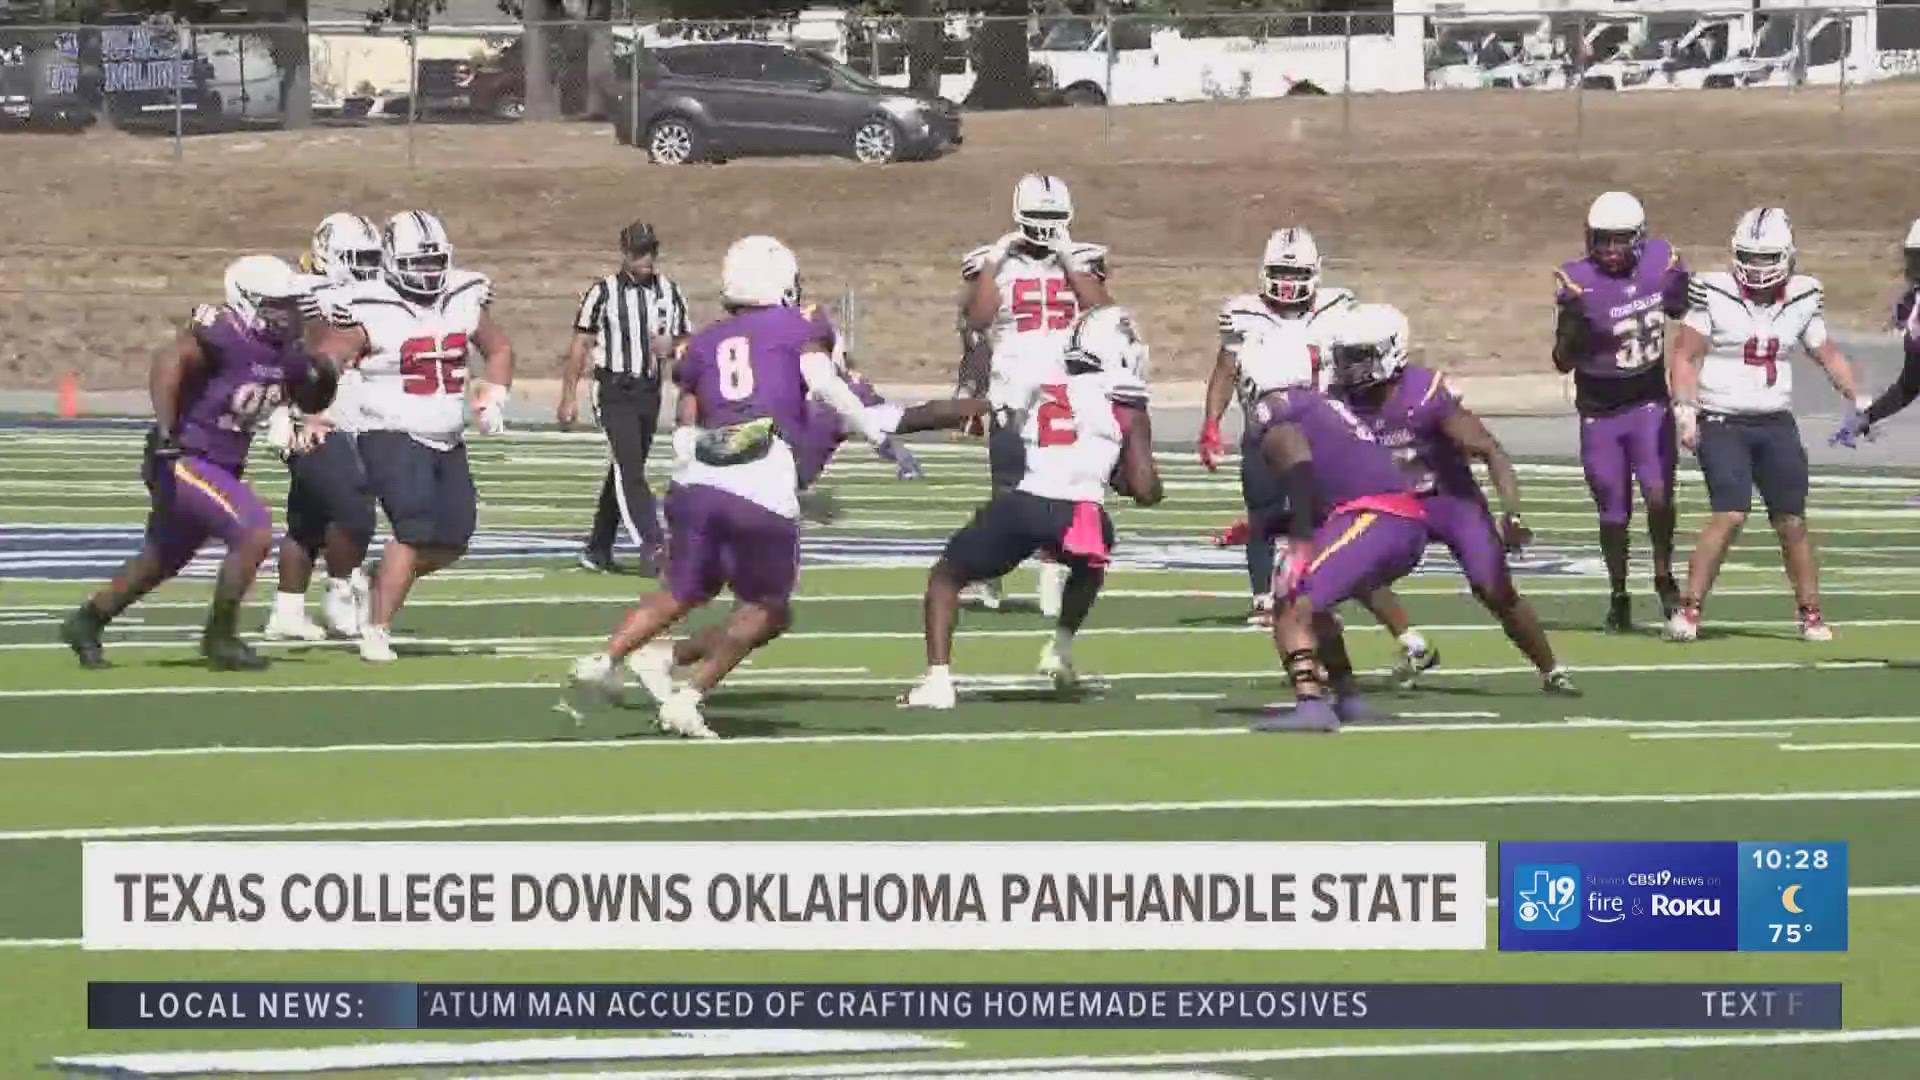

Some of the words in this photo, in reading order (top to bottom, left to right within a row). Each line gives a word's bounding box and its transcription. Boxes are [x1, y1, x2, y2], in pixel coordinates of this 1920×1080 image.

[1012, 278, 1076, 333] 55
[400, 332, 467, 396] 52
[717, 336, 754, 401] 8
[1744, 337, 1780, 387] 4
[1038, 384, 1077, 447] 2
